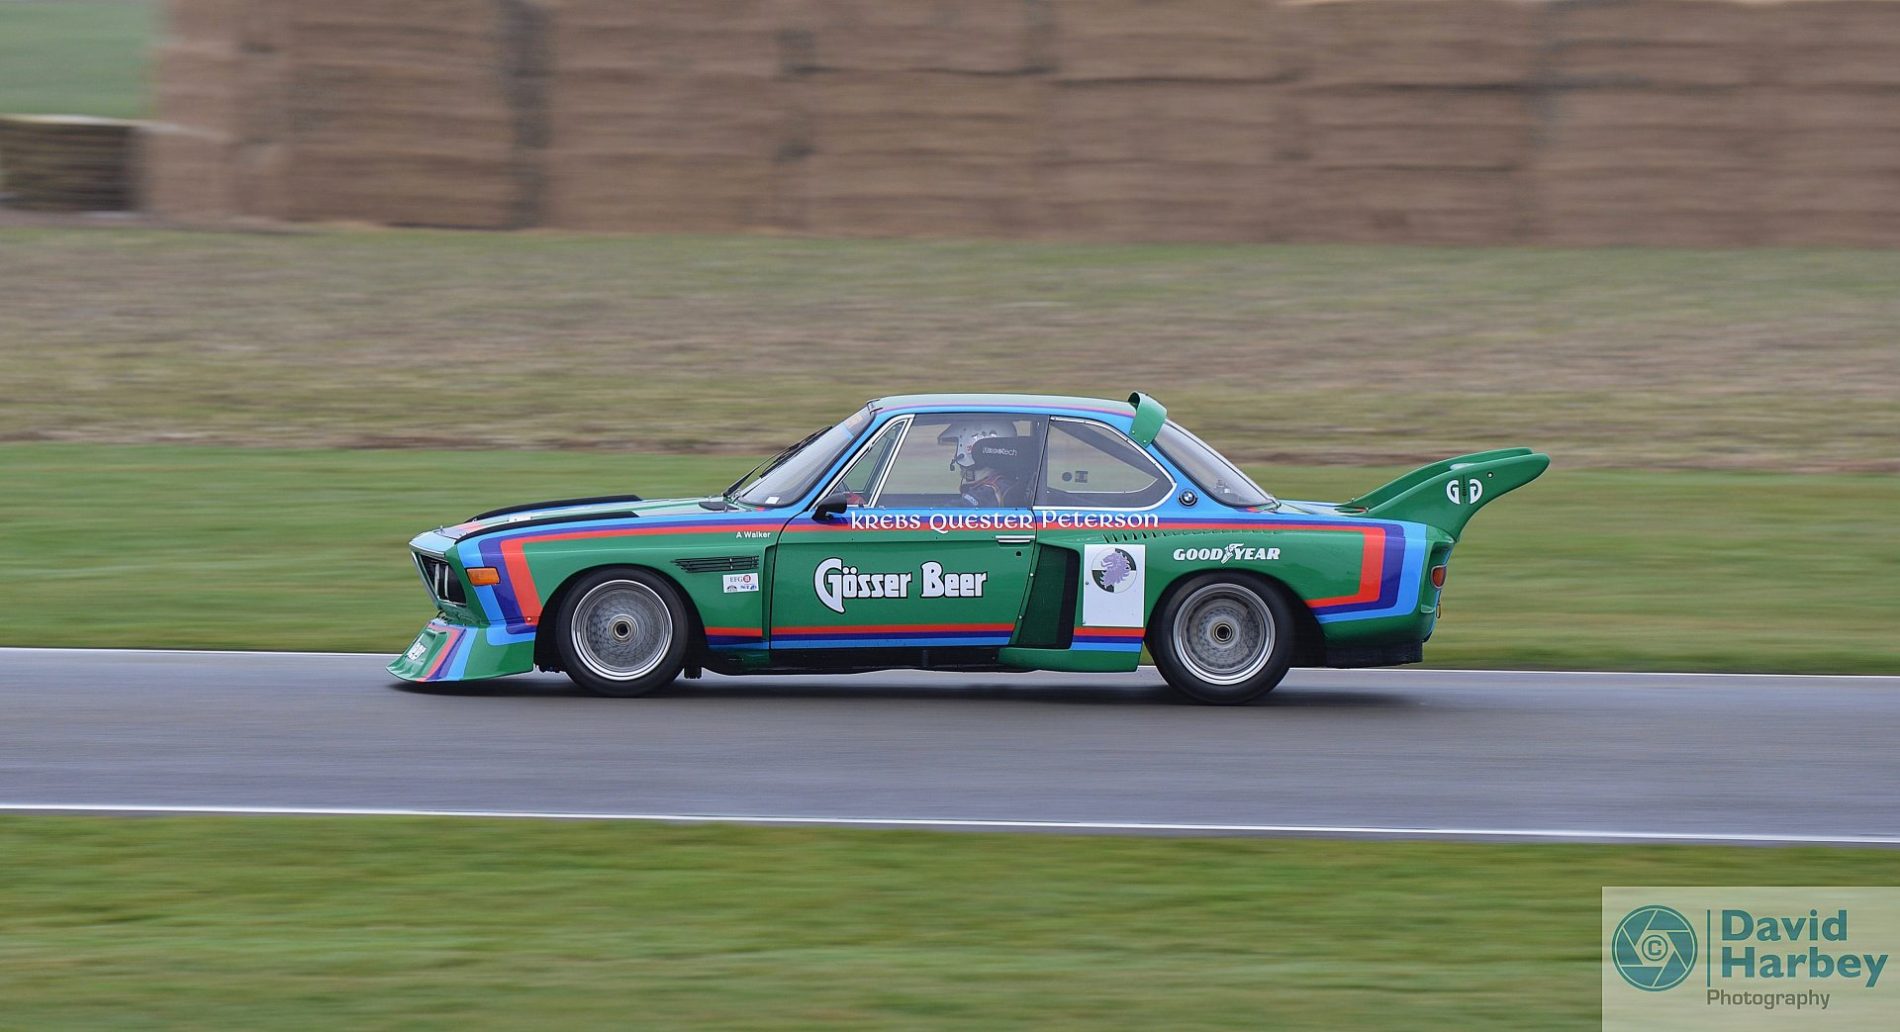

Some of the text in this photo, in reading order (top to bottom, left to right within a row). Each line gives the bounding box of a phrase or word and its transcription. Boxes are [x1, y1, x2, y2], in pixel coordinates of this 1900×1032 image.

[736, 530, 771, 539] A Walker
[1173, 546, 1281, 562] GOODYEAR
[814, 557, 988, 614] Gösser Beer
